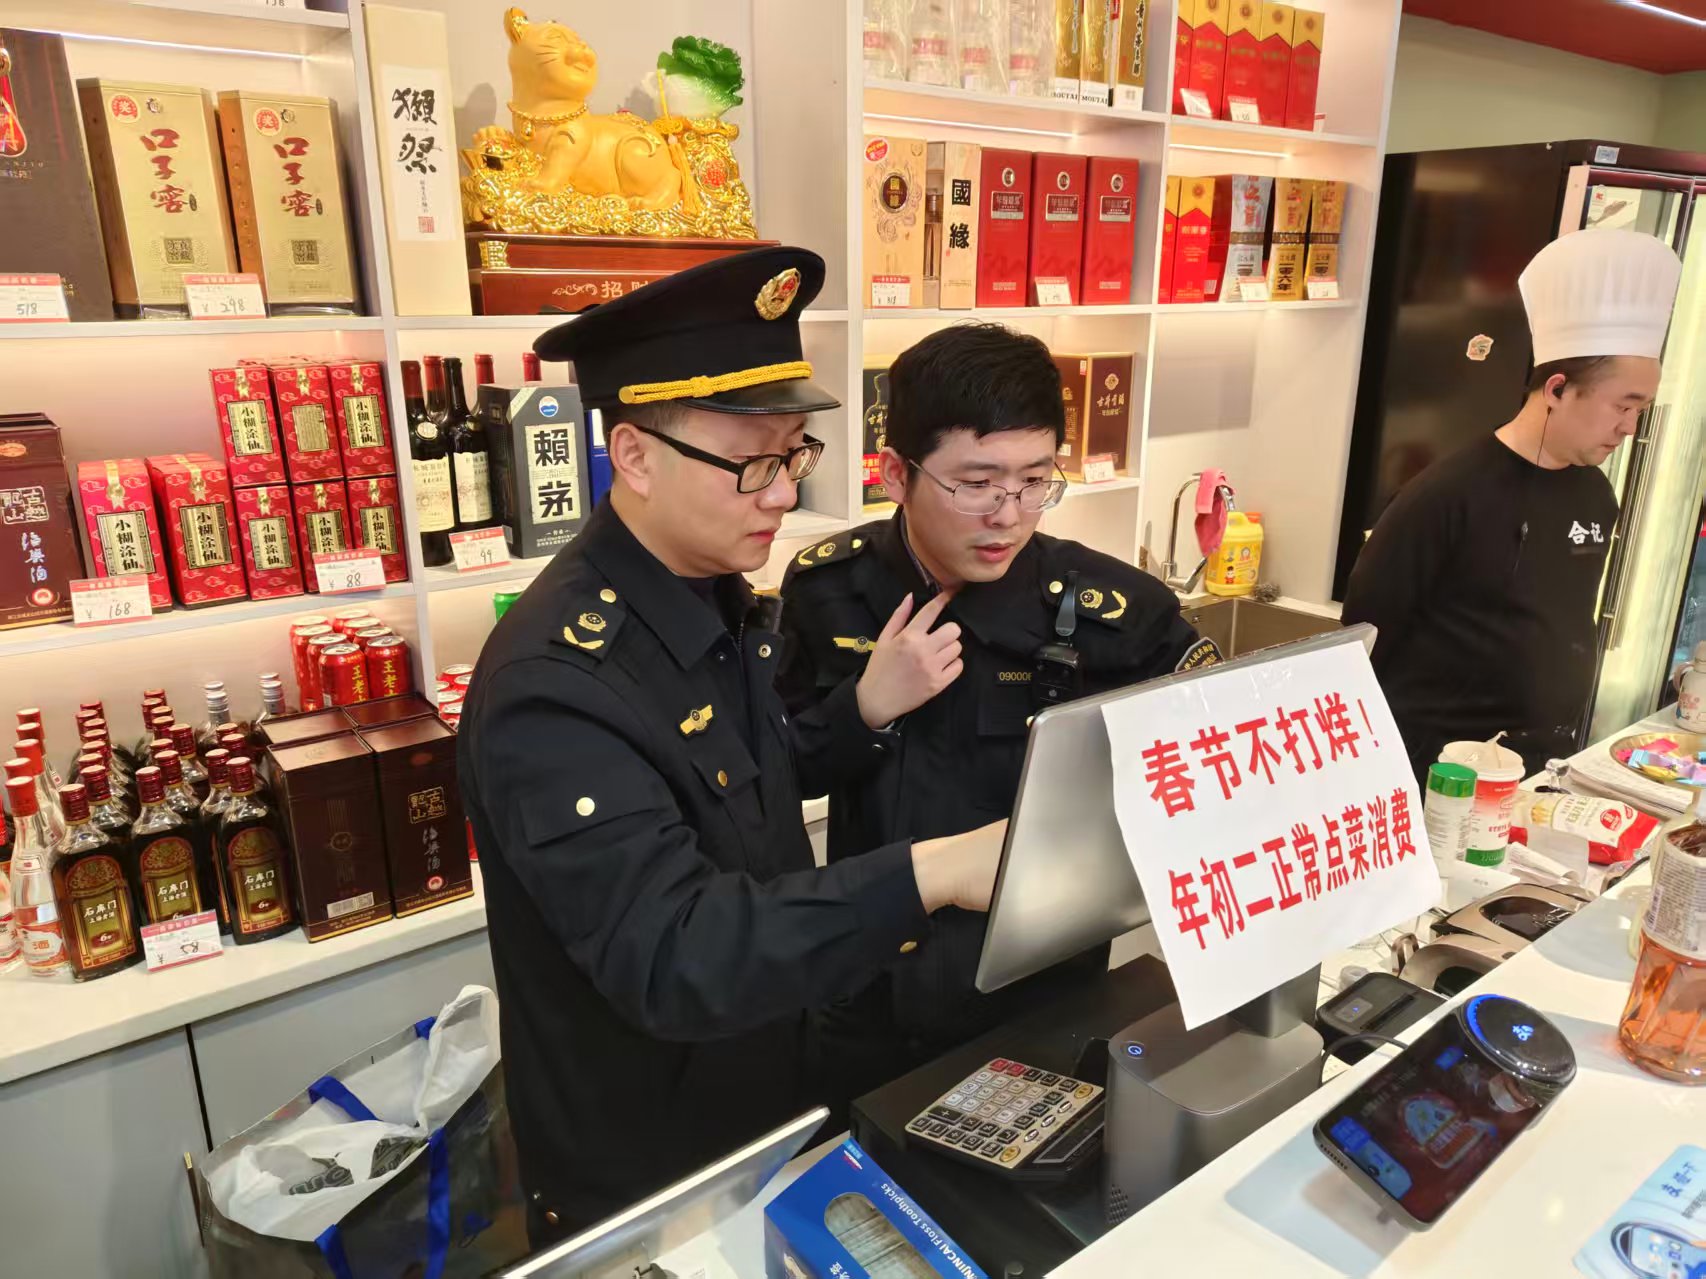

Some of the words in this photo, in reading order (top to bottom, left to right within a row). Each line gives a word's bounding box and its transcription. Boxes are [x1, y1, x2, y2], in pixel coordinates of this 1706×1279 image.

[140, 128, 188, 213] 口子窖
[273, 137, 316, 216] 口子窖
[949, 179, 972, 249] 國緣
[221, 298, 245, 313] 298
[241, 407, 264, 450] 小糊涂仙
[356, 401, 376, 443] 小糊涂仙
[115, 519, 139, 571] 小糊涂仙
[197, 512, 217, 562] 小糊涂仙
[261, 523, 280, 565] 小糊涂仙
[346, 573, 361, 587] 88
[109, 602, 131, 618] 168
[1141, 691, 1380, 818] 春节不打烊！
[1168, 787, 1416, 950] 年初二正常点菜消费
[880, 1183, 923, 1226] Toothpicks
[920, 1221, 943, 1247] Floss
